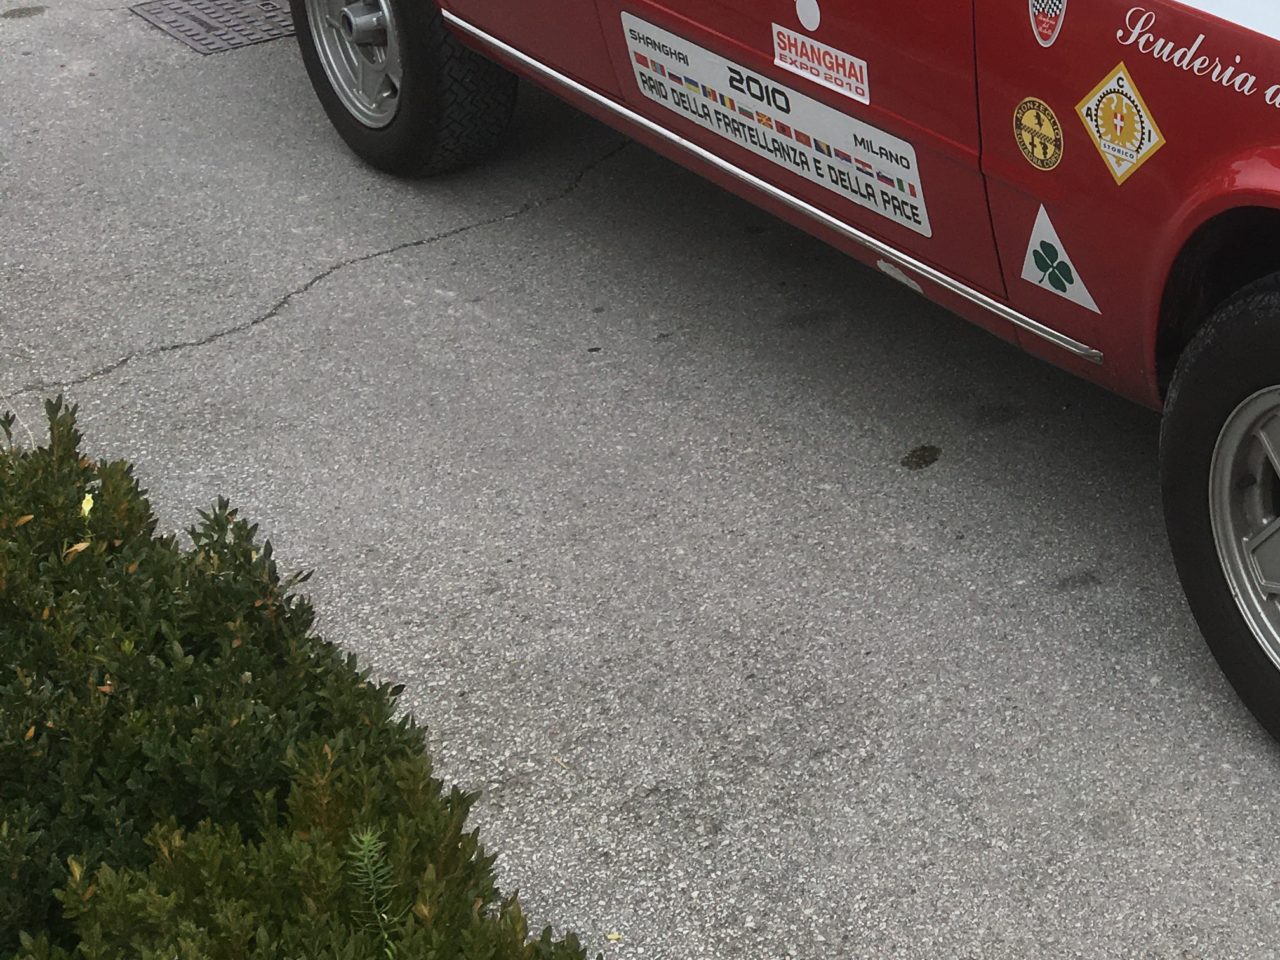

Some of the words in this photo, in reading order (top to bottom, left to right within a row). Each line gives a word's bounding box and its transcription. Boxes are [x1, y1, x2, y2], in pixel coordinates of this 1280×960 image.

[629, 28, 689, 67] SHANGHAI
[776, 29, 864, 85] SHANGHAI
[1116, 7, 1257, 96] Scuderia
[726, 66, 791, 115] 2010
[778, 52, 820, 77] EXPO
[824, 73, 865, 98] 2010
[1017, 101, 1060, 139] MONZEGLIO
[639, 71, 668, 100] RAID
[671, 86, 713, 121] DELLA
[715, 108, 810, 172] FRATELLANZA
[813, 157, 825, 178] E
[828, 165, 878, 207] DELLA
[881, 190, 922, 226] PACE
[853, 133, 910, 170] MILANO
[1103, 143, 1135, 160] STORICO
